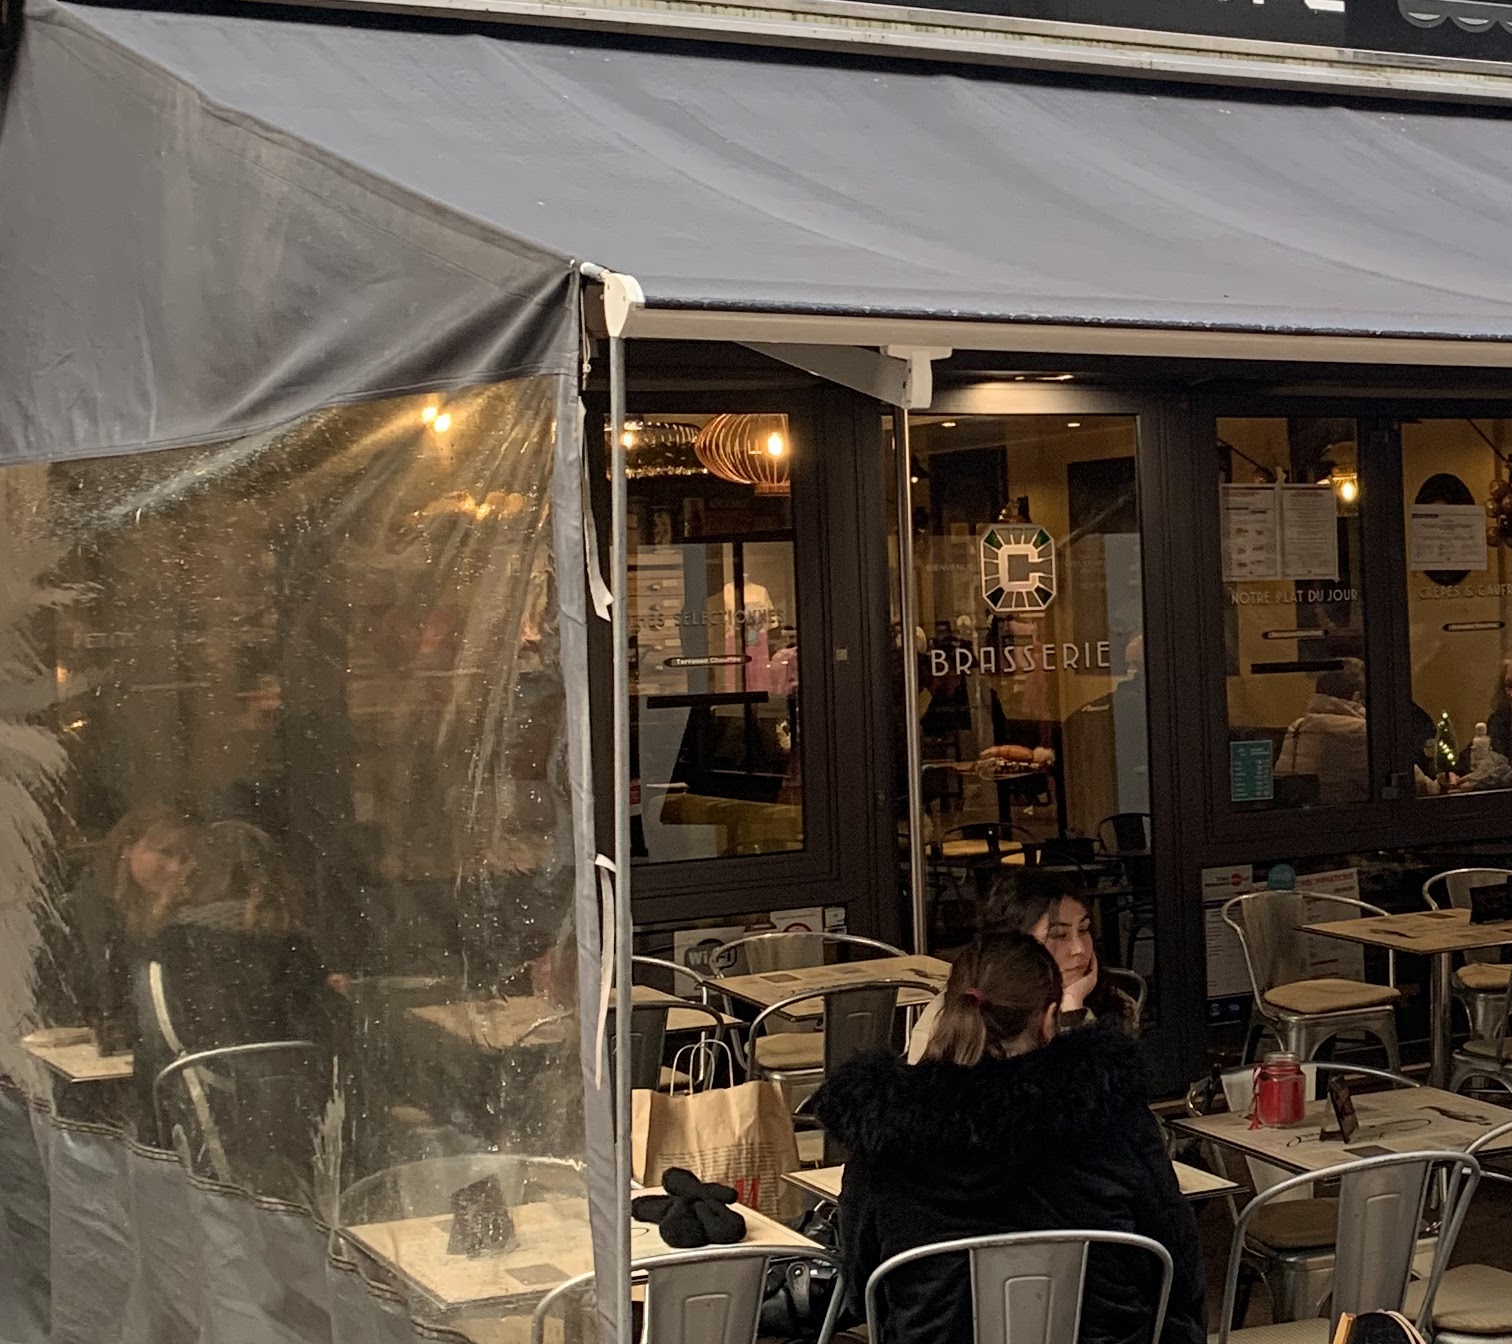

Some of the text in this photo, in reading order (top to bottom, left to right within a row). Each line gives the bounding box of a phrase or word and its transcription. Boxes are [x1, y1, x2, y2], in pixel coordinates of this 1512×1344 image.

[1232, 589, 1358, 604] NOTRE PLAT DU JOUR
[931, 641, 1110, 677] BRASSERIE
